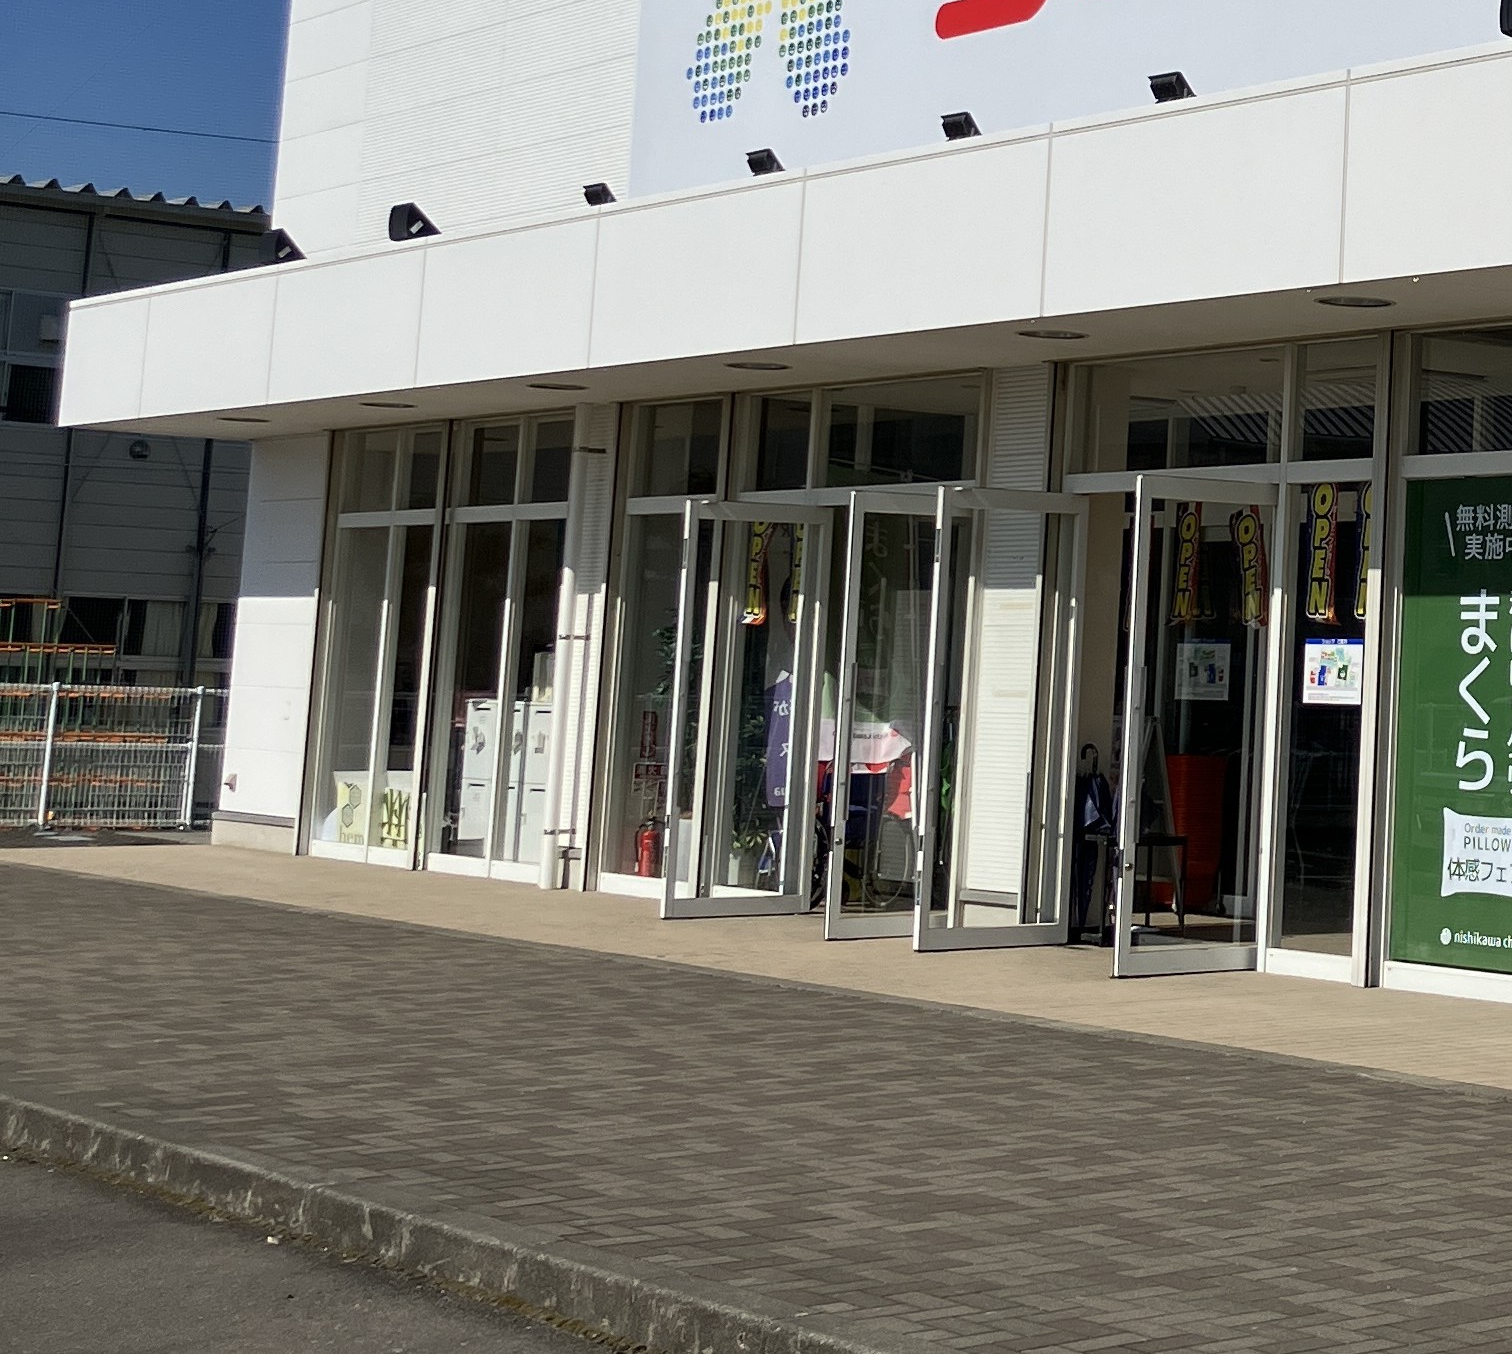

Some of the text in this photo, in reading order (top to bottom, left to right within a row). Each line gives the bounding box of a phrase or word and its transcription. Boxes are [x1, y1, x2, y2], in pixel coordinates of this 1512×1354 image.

[1172, 511, 1200, 621] OPEN
[1235, 513, 1263, 626] OPEN
[1306, 480, 1337, 616] OPEN
[1455, 588, 1501, 792] まくら
[1463, 822, 1512, 836] Order made
[1463, 835, 1512, 853] PILLOW
[1453, 929, 1502, 948] nishikawa
